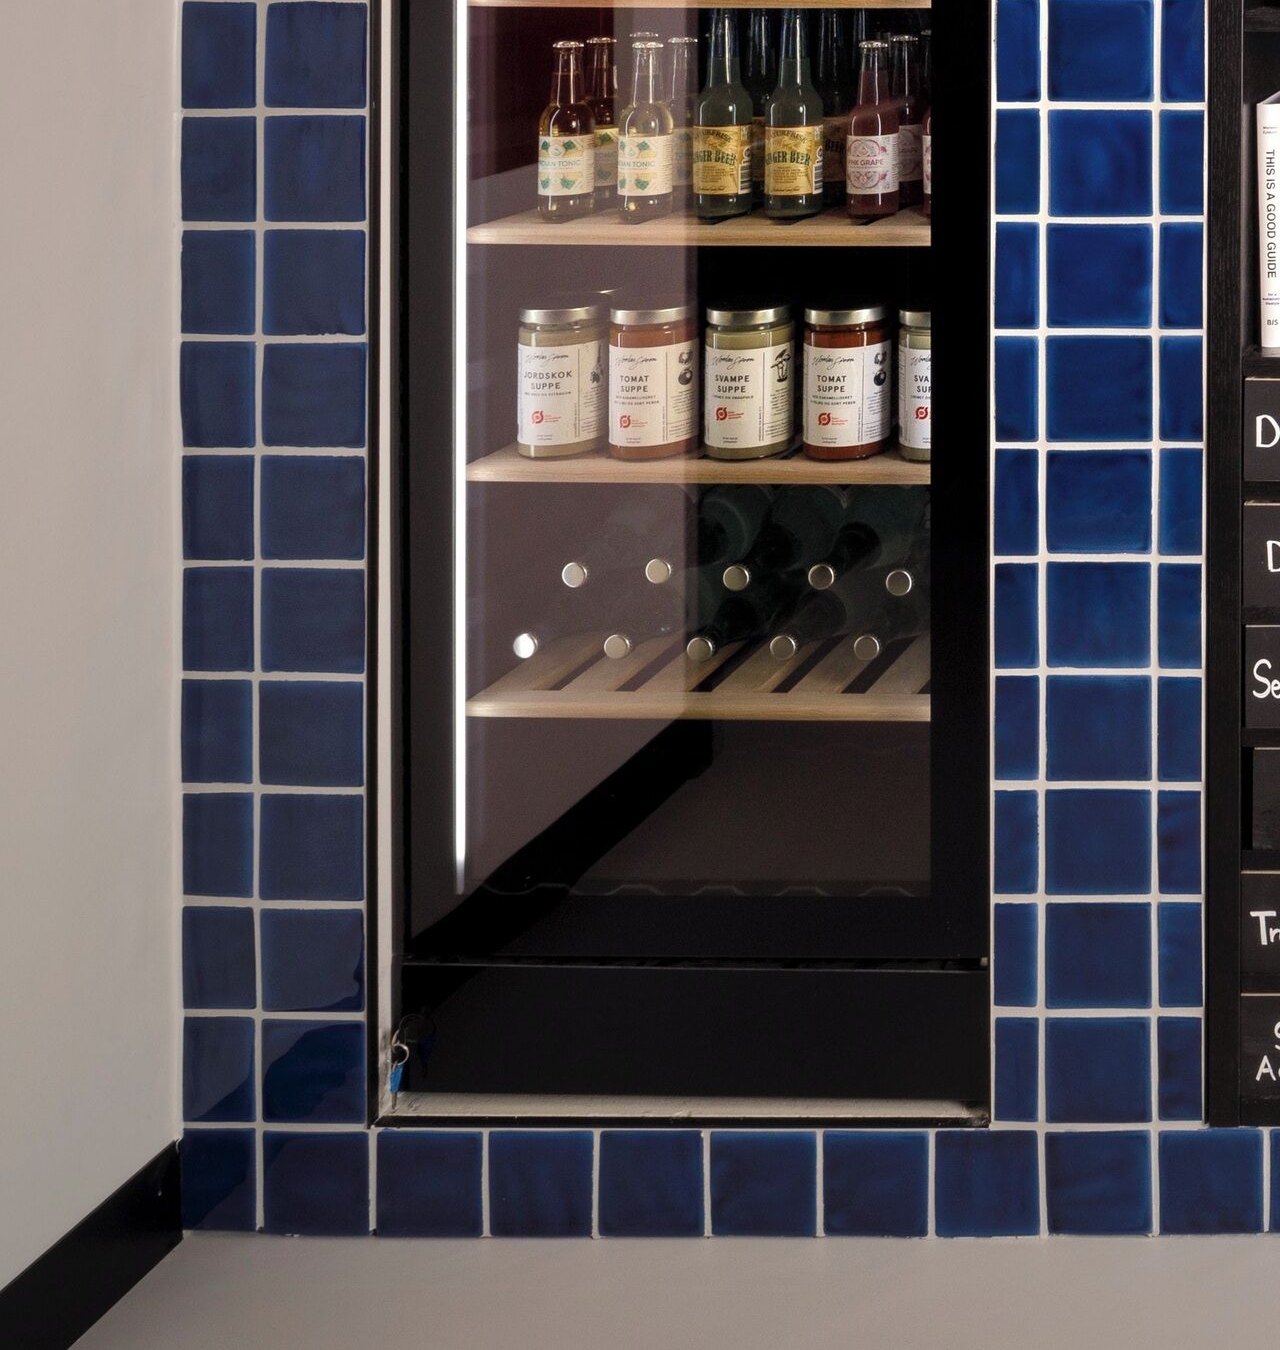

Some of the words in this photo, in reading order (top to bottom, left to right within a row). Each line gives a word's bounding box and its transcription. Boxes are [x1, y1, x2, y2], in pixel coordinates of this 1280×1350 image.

[1266, 150, 1276, 176] THIS
[1266, 179, 1276, 190] IS
[1266, 192, 1276, 201] A
[1267, 203, 1277, 239] GOOD
[1267, 242, 1277, 279] GUIDE
[524, 370, 573, 380] JORDSKOK
[620, 375, 650, 383] TOMAT
[715, 374, 750, 383] SVAMPE
[816, 375, 847, 383] TOMAT
[530, 382, 561, 391] SUPPE
[620, 385, 649, 393] SUPPE
[717, 385, 746, 393] SUPPE
[817, 385, 845, 393] SUPPE
